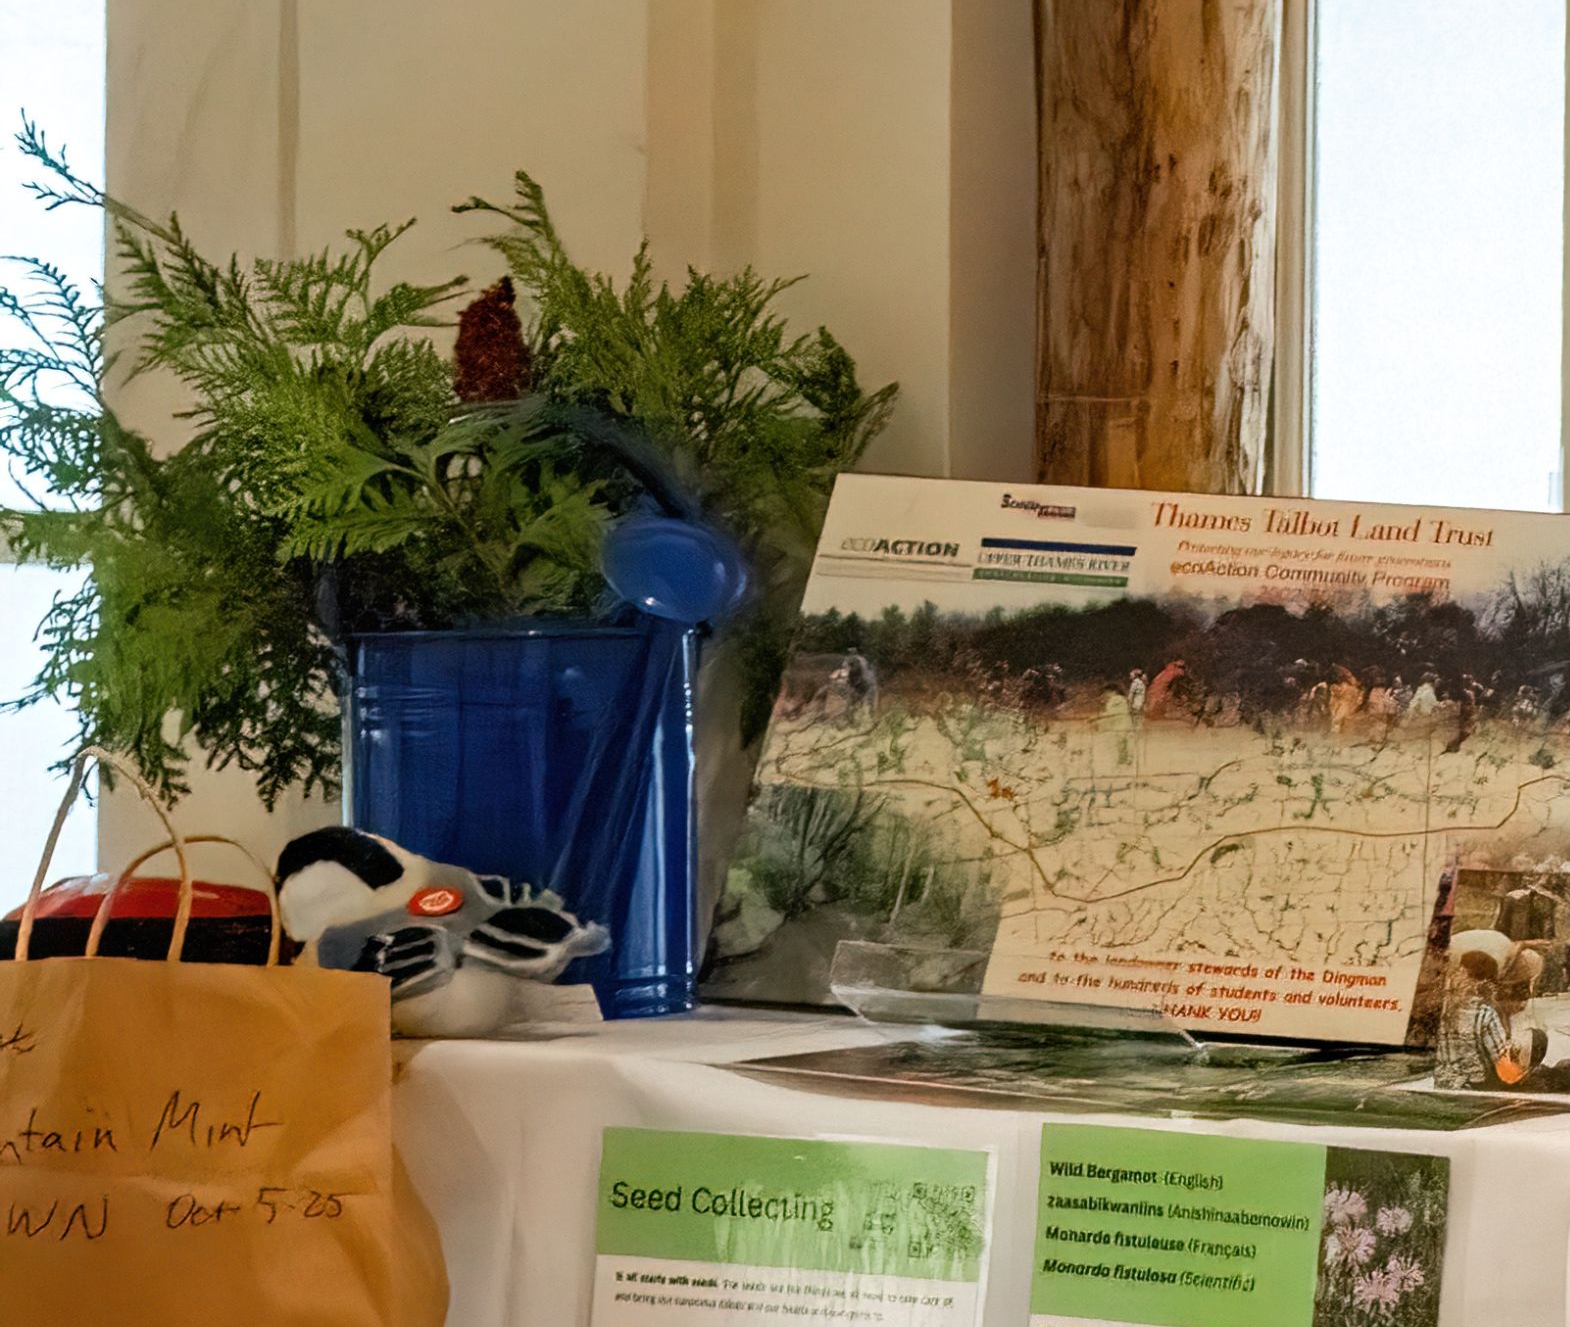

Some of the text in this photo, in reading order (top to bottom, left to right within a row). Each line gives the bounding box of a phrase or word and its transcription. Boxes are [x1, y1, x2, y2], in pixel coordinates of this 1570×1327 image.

[1150, 501, 1251, 532] Thames
[1263, 508, 1339, 539] Talbot
[1350, 513, 1421, 543] Land
[1429, 519, 1496, 547] Trust
[1169, 560, 1450, 590] ecoAction Community Program
[151, 1090, 283, 1152] Mint
[1049, 1161, 1224, 1190] Wild Bergamot (English)
[611, 1181, 834, 1232] Seed Collecting
[1180, 1271, 1255, 1292] (Scientific)
